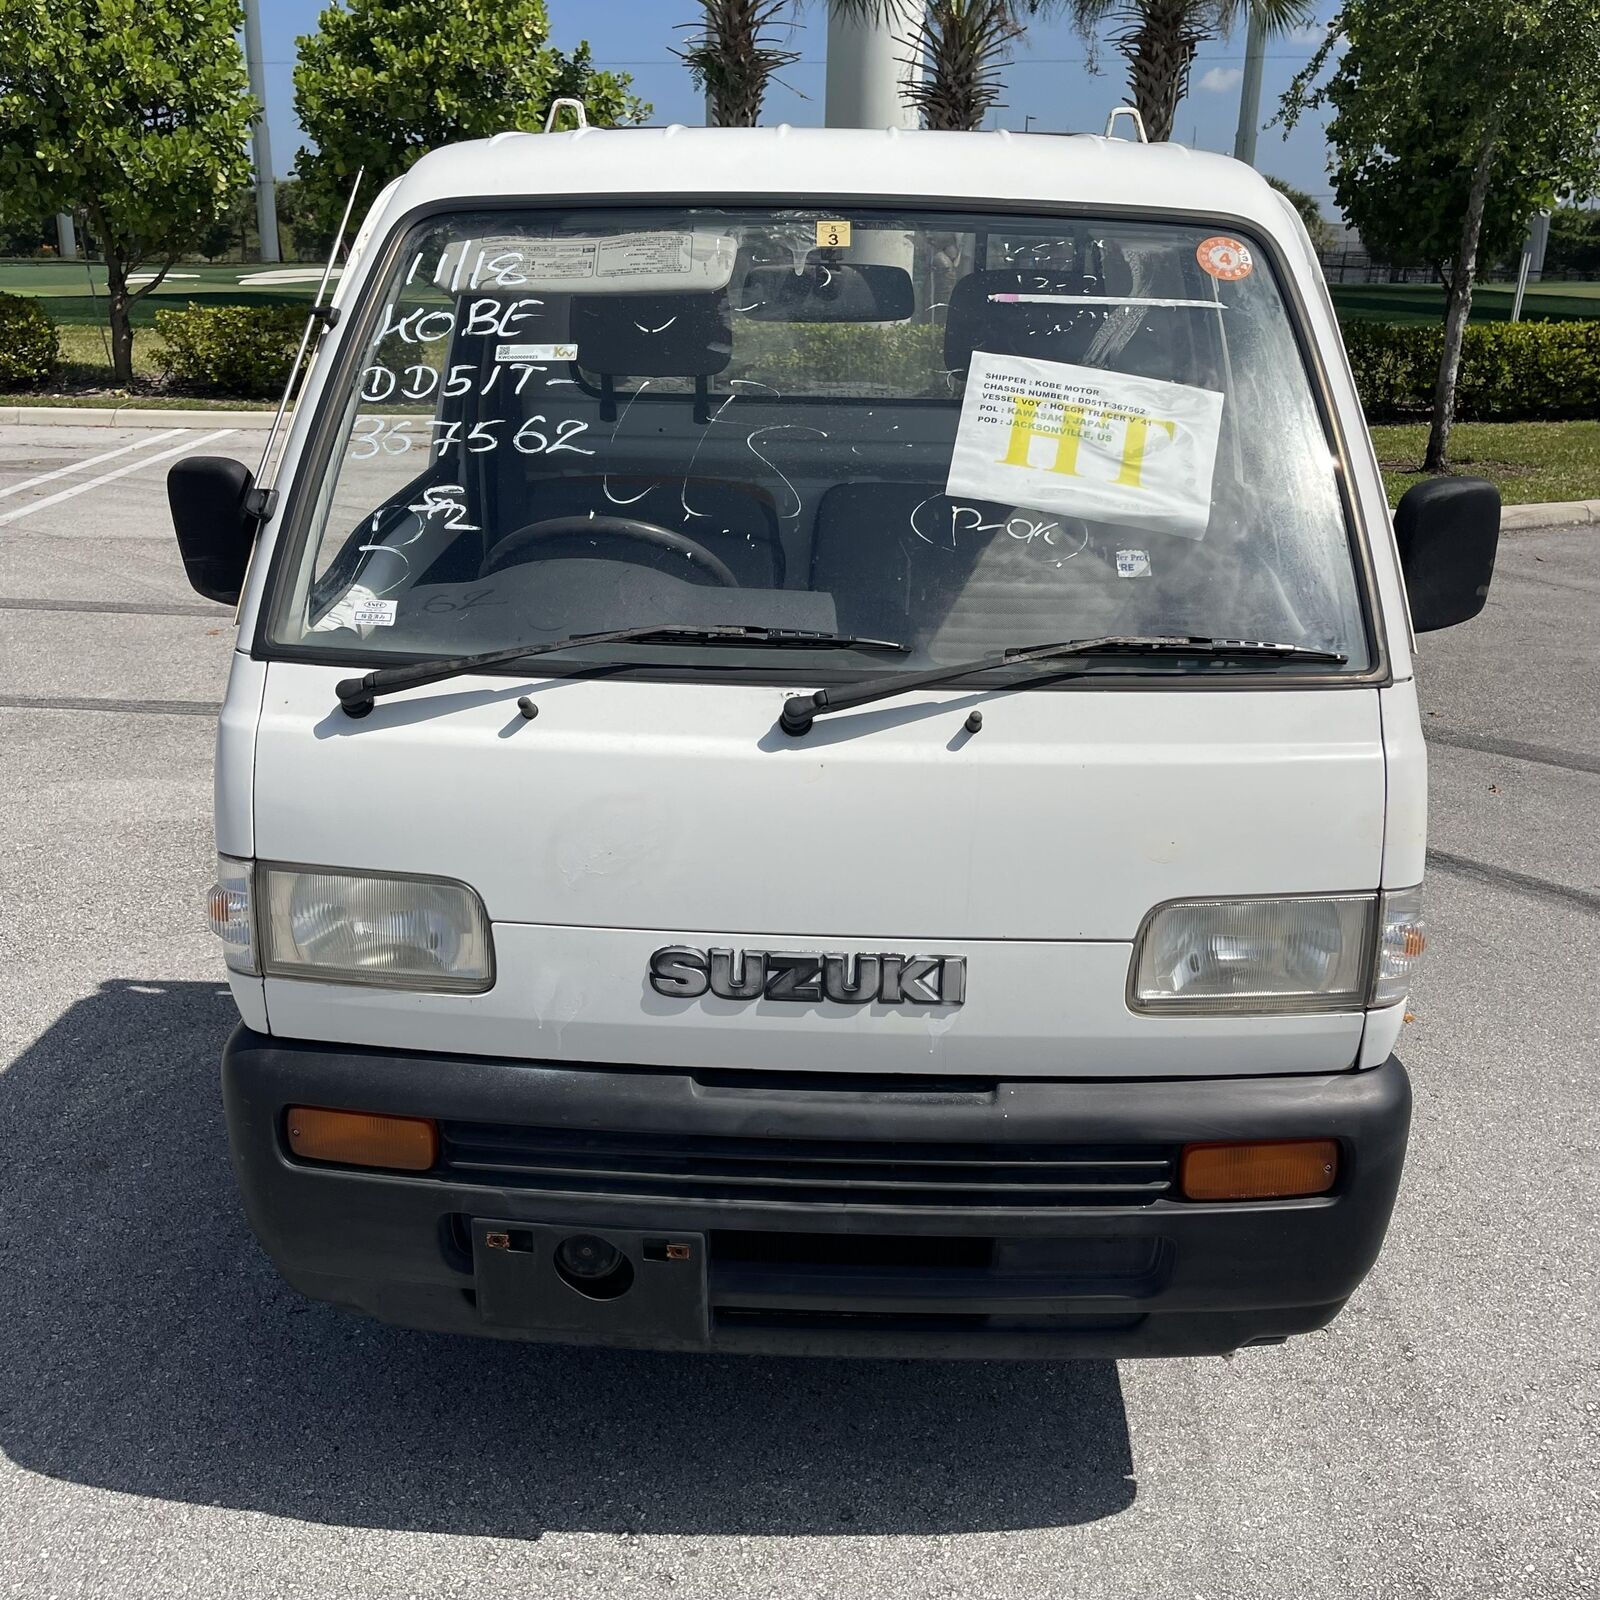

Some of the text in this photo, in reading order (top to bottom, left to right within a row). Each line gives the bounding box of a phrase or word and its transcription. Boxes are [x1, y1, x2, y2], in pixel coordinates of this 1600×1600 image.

[828, 234, 839, 246] 3
[830, 225, 837, 233] 5
[1219, 252, 1232, 265] 4
[373, 298, 544, 346] KOBE
[985, 372, 1027, 385] SHIPPER
[1035, 380, 1062, 390] KOBE
[1064, 384, 1100, 396] MOTOR
[982, 392, 1018, 404] VESSEL
[1021, 399, 1042, 408] VOY
[1049, 403, 1084, 415] HOEGH
[1088, 409, 1127, 422] TRACER
[983, 382, 1025, 395] CHASSIS
[1028, 389, 1069, 401] NUMBER
[1078, 397, 1146, 415] DD51T-367562
[977, 416, 998, 424] POD
[1006, 419, 1094, 440] JACKSONVILLE,
[1097, 433, 1113, 442] US
[980, 404, 998, 413] POL
[1007, 407, 1069, 425] KAWASAKI,
[1072, 418, 1110, 430] JAPAN
[351, 415, 596, 460] 367562
[994, 396, 1177, 489] HT
[1119, 563, 1135, 571] RE
[649, 945, 967, 1005] SUZUKI
